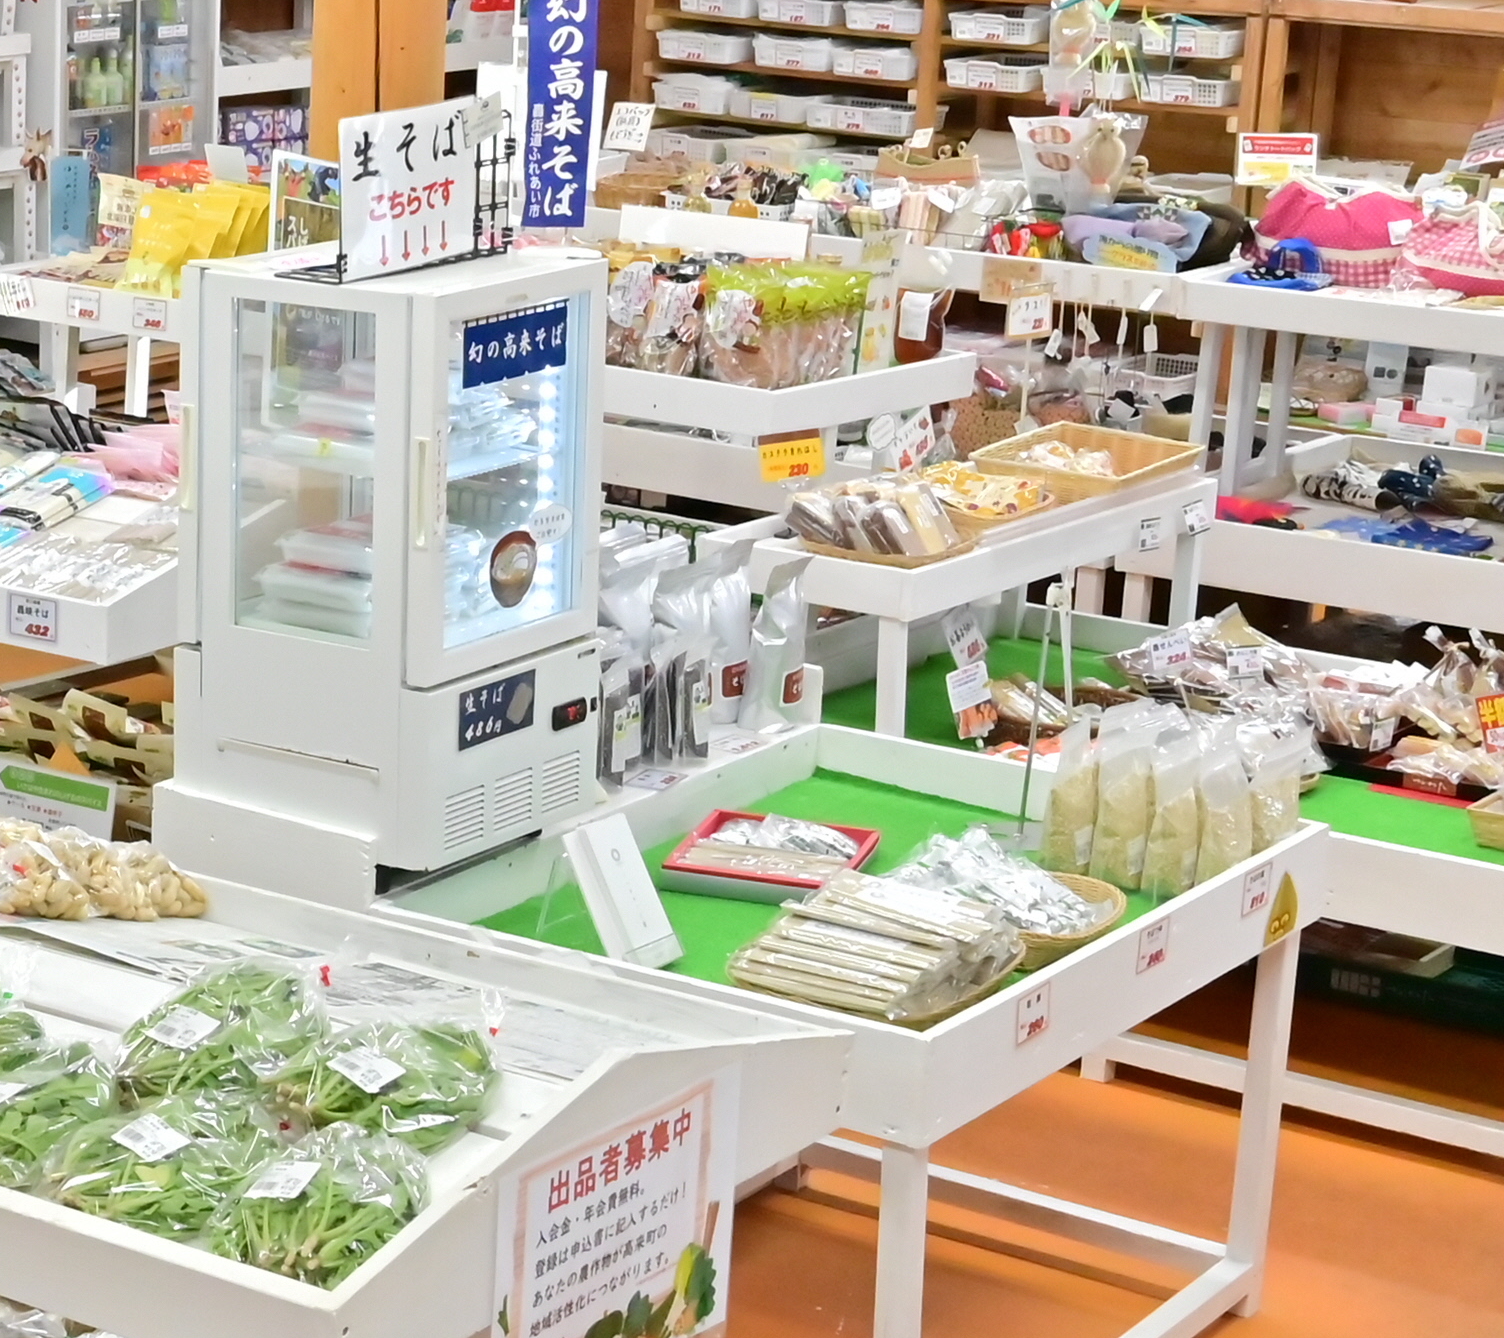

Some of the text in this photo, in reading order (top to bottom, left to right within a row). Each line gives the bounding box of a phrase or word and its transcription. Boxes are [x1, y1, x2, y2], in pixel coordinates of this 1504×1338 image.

[352, 108, 464, 182] 生そば
[369, 177, 455, 222] こちらです
[468, 321, 565, 364] 幻の高来そば
[464, 715, 503, 742] 486円
[465, 682, 507, 716] 生そば
[548, 1107, 693, 1215] 出品者募集中
[534, 1180, 688, 1281] 登録は申込書に記入するだけ！
[535, 1179, 646, 1250] 入会金・年会費無料。
[529, 1251, 671, 1338] 地域活性化につながります。
[532, 1222, 669, 1309] あなたの農作物が高来町の
